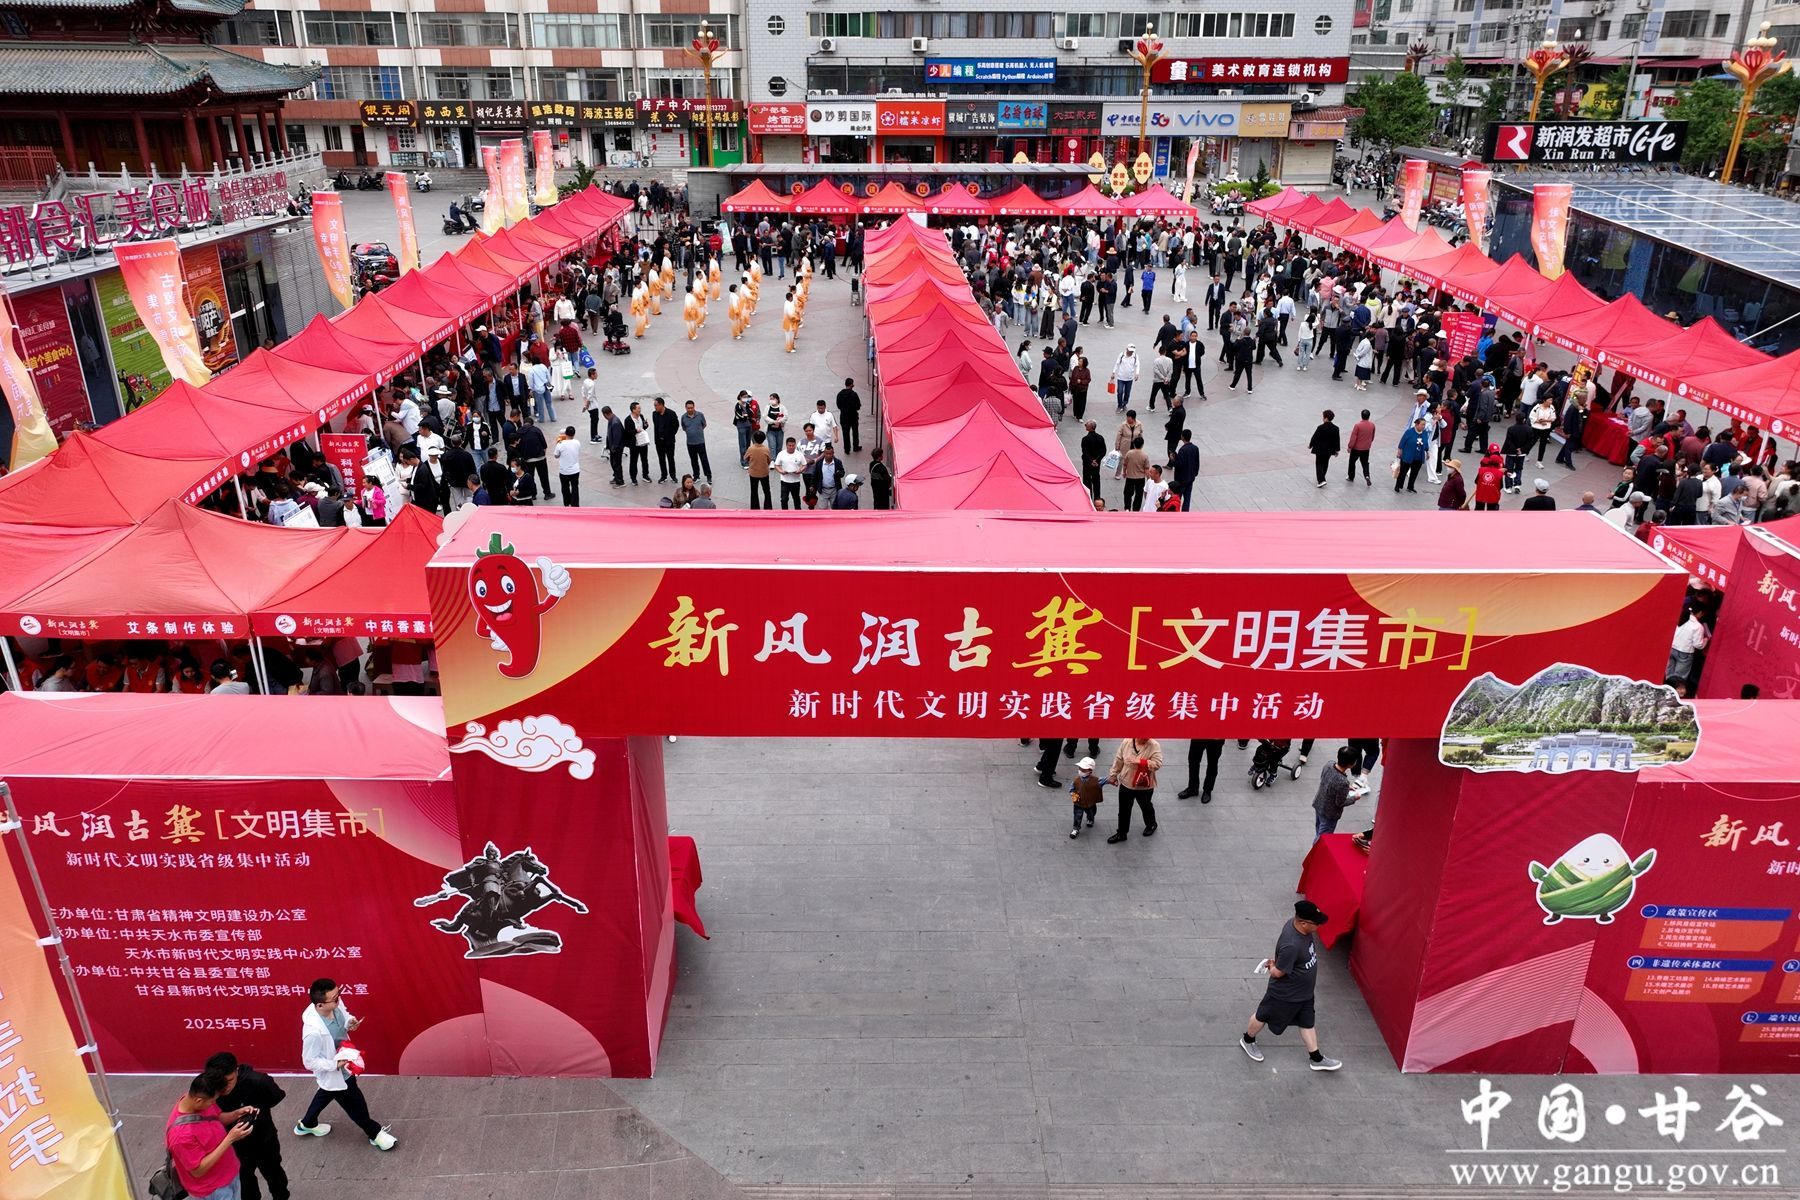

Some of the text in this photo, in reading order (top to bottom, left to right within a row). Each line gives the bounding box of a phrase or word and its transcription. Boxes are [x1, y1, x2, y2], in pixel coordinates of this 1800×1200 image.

[929, 64, 975, 77] 少儿编程
[1211, 63, 1332, 78] 美术教育连锁机构
[423, 105, 467, 118] 西西里
[642, 99, 691, 111] 房产中介
[825, 110, 872, 122] 妙剪国际
[1121, 114, 1148, 122] 中国电
[1150, 112, 1170, 127] 5G
[1178, 110, 1235, 127] vivo
[1536, 125, 1632, 148] 新润发超市
[1542, 149, 1616, 160] Xin Run Fa
[1757, 569, 1800, 622] 新风
[126, 620, 236, 635] 艾条制作体验
[789, 688, 1326, 720] 新时代文明实践省级集中活动
[1700, 814, 1800, 852] 新风
[66, 850, 311, 870] 新时代文明实践省级集中活动
[1666, 908, 1718, 918] 政策宣传区
[125, 945, 363, 961] 天水市新时代文明实践中心办公室
[1652, 959, 1722, 969] 非遗传承体验区
[135, 982, 370, 998] 甘谷县新时代文明实践中公室
[184, 1017, 267, 1031] 2025年5月
